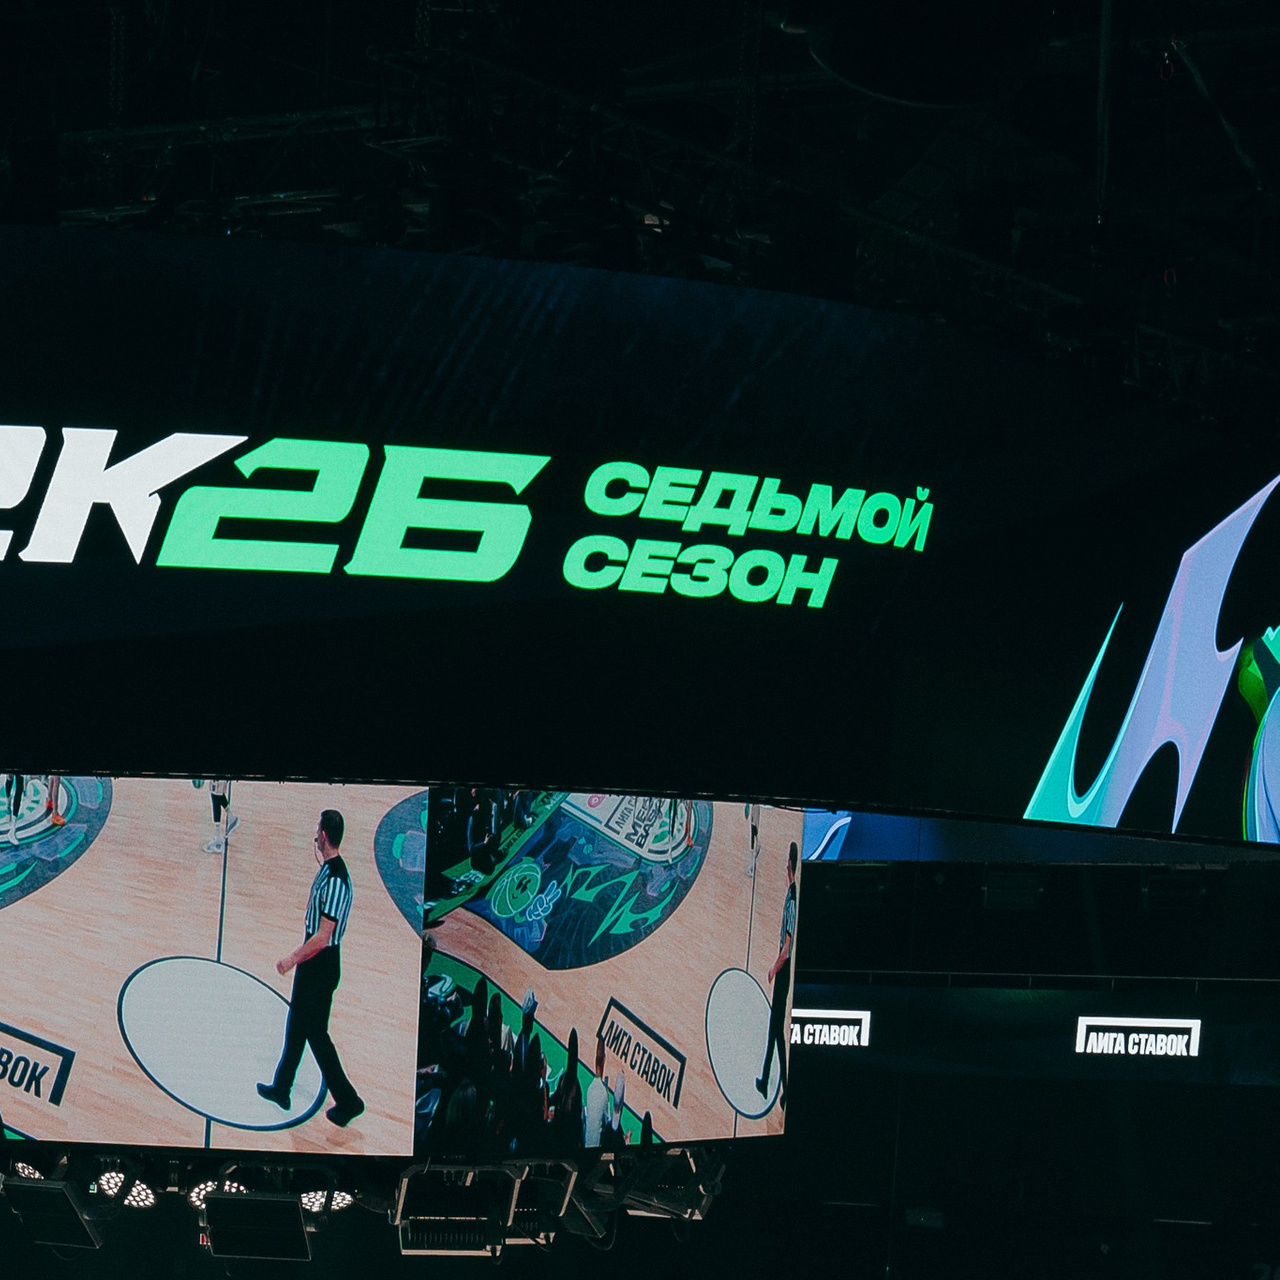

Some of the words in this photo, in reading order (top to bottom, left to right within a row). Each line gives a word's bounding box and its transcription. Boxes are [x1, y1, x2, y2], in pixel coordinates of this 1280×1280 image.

[584, 460, 933, 553] СЕДЬМОЙ
[561, 535, 838, 608] СЕЗОН
[804, 1023, 860, 1047] СТАВОК
[1086, 1031, 1126, 1054] ЛИГА
[1128, 1033, 1190, 1057] СТАВОК
[630, 1041, 677, 1103] СТАВОК
